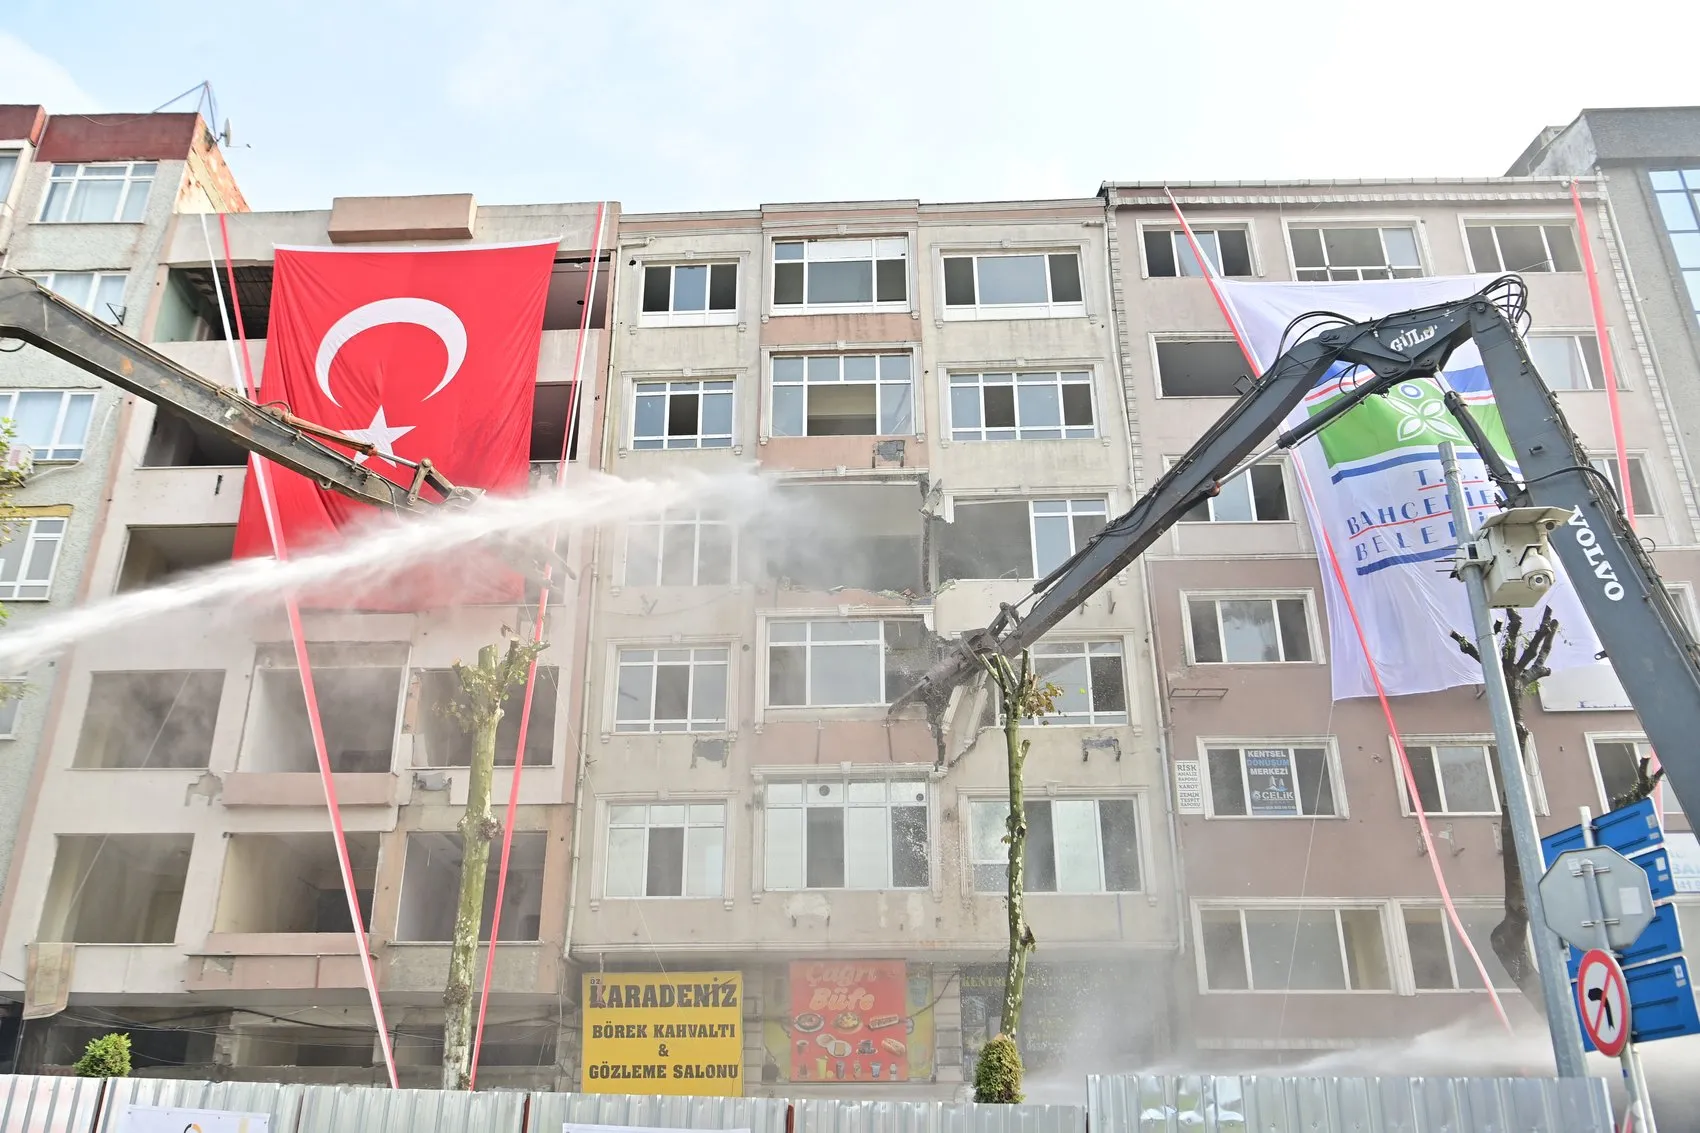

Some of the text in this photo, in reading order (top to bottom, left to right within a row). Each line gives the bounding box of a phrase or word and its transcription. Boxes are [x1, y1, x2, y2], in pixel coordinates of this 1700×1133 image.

[1567, 504, 1625, 602] VOLVO
[1247, 750, 1287, 758] KENTSEL
[1250, 766, 1289, 775] MERKEZİ
[589, 977, 737, 1009] KARADENİZ
[809, 987, 875, 1011] Büfe
[592, 1020, 736, 1039] BÖREK KAHVALTI
[658, 1043, 670, 1057] &
[588, 1060, 739, 1079] GÖZLEME SALONU
